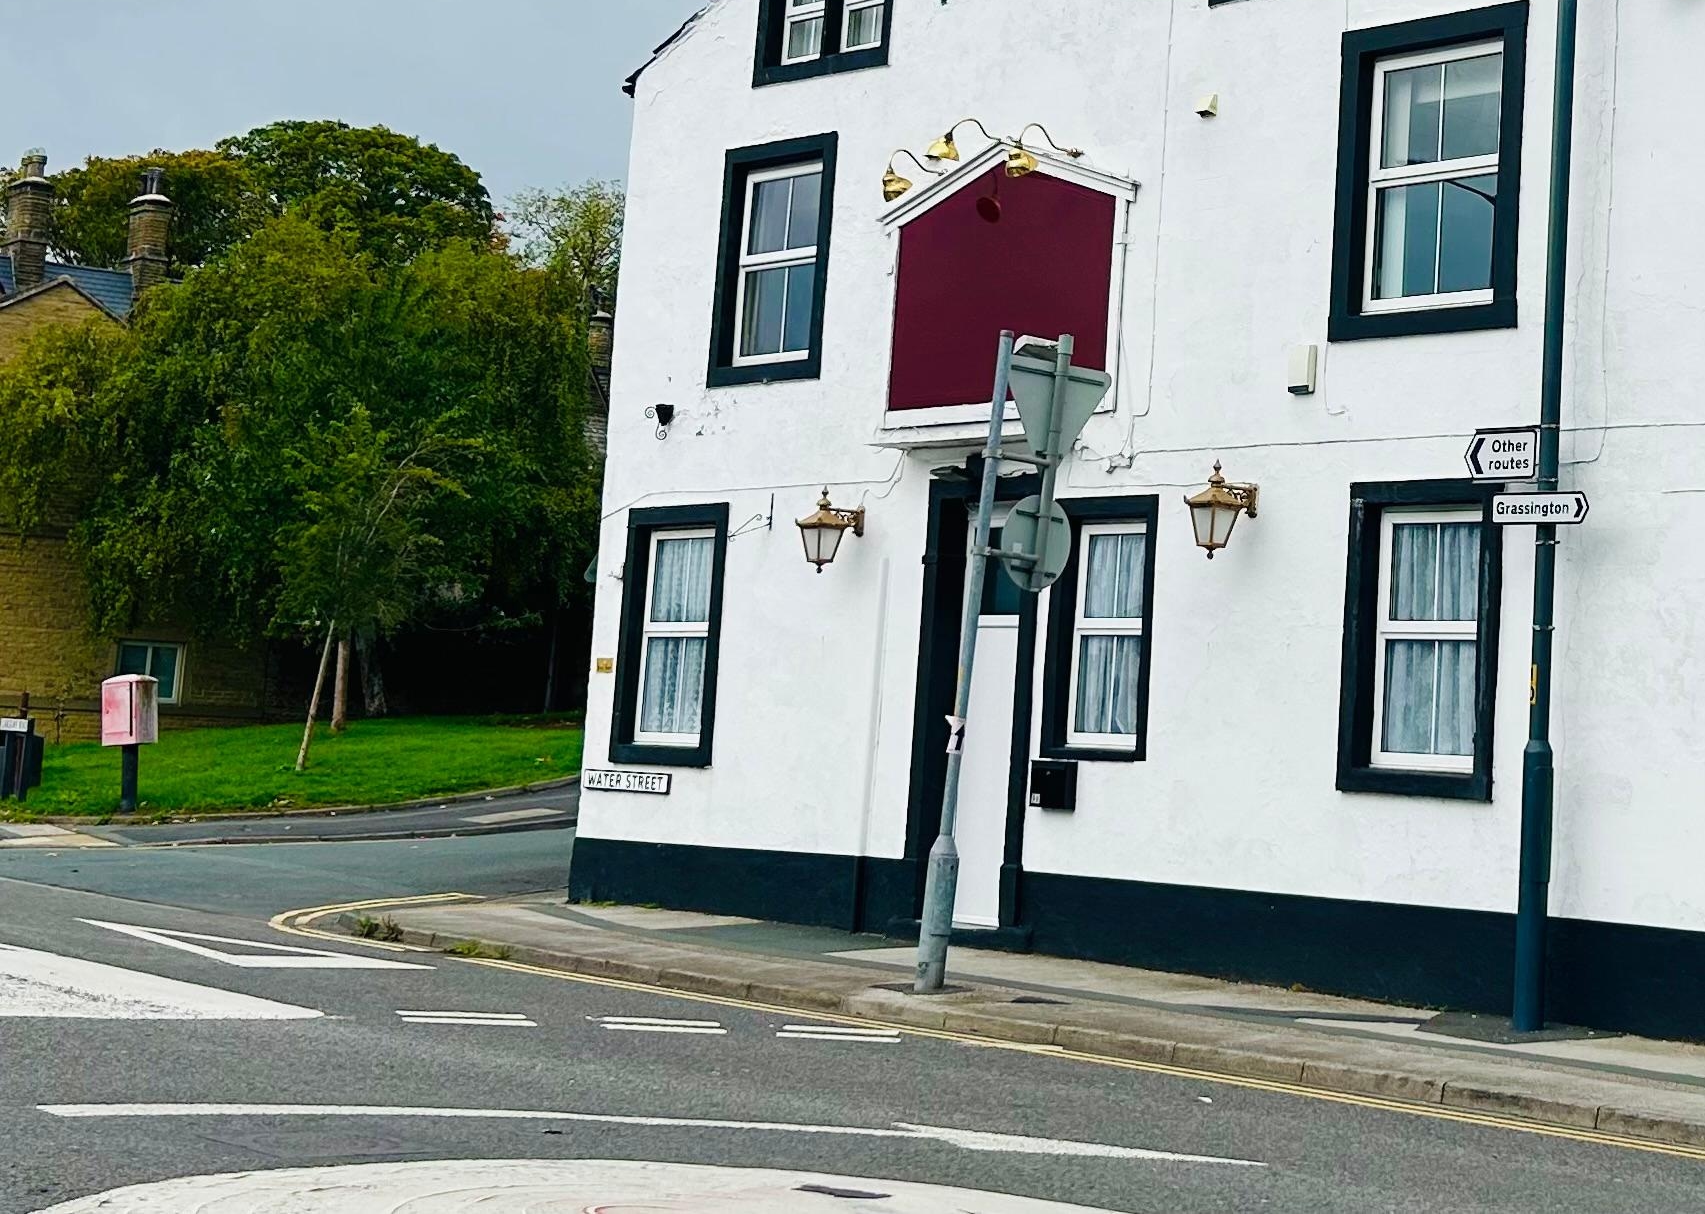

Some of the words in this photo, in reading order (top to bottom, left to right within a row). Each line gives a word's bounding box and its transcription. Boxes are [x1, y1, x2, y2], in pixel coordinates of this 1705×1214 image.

[1491, 439, 1528, 453] Other
[1488, 456, 1529, 470] routes
[1496, 500, 1569, 517] Grassington
[588, 773, 621, 788] WATER
[626, 774, 664, 791] STREET
